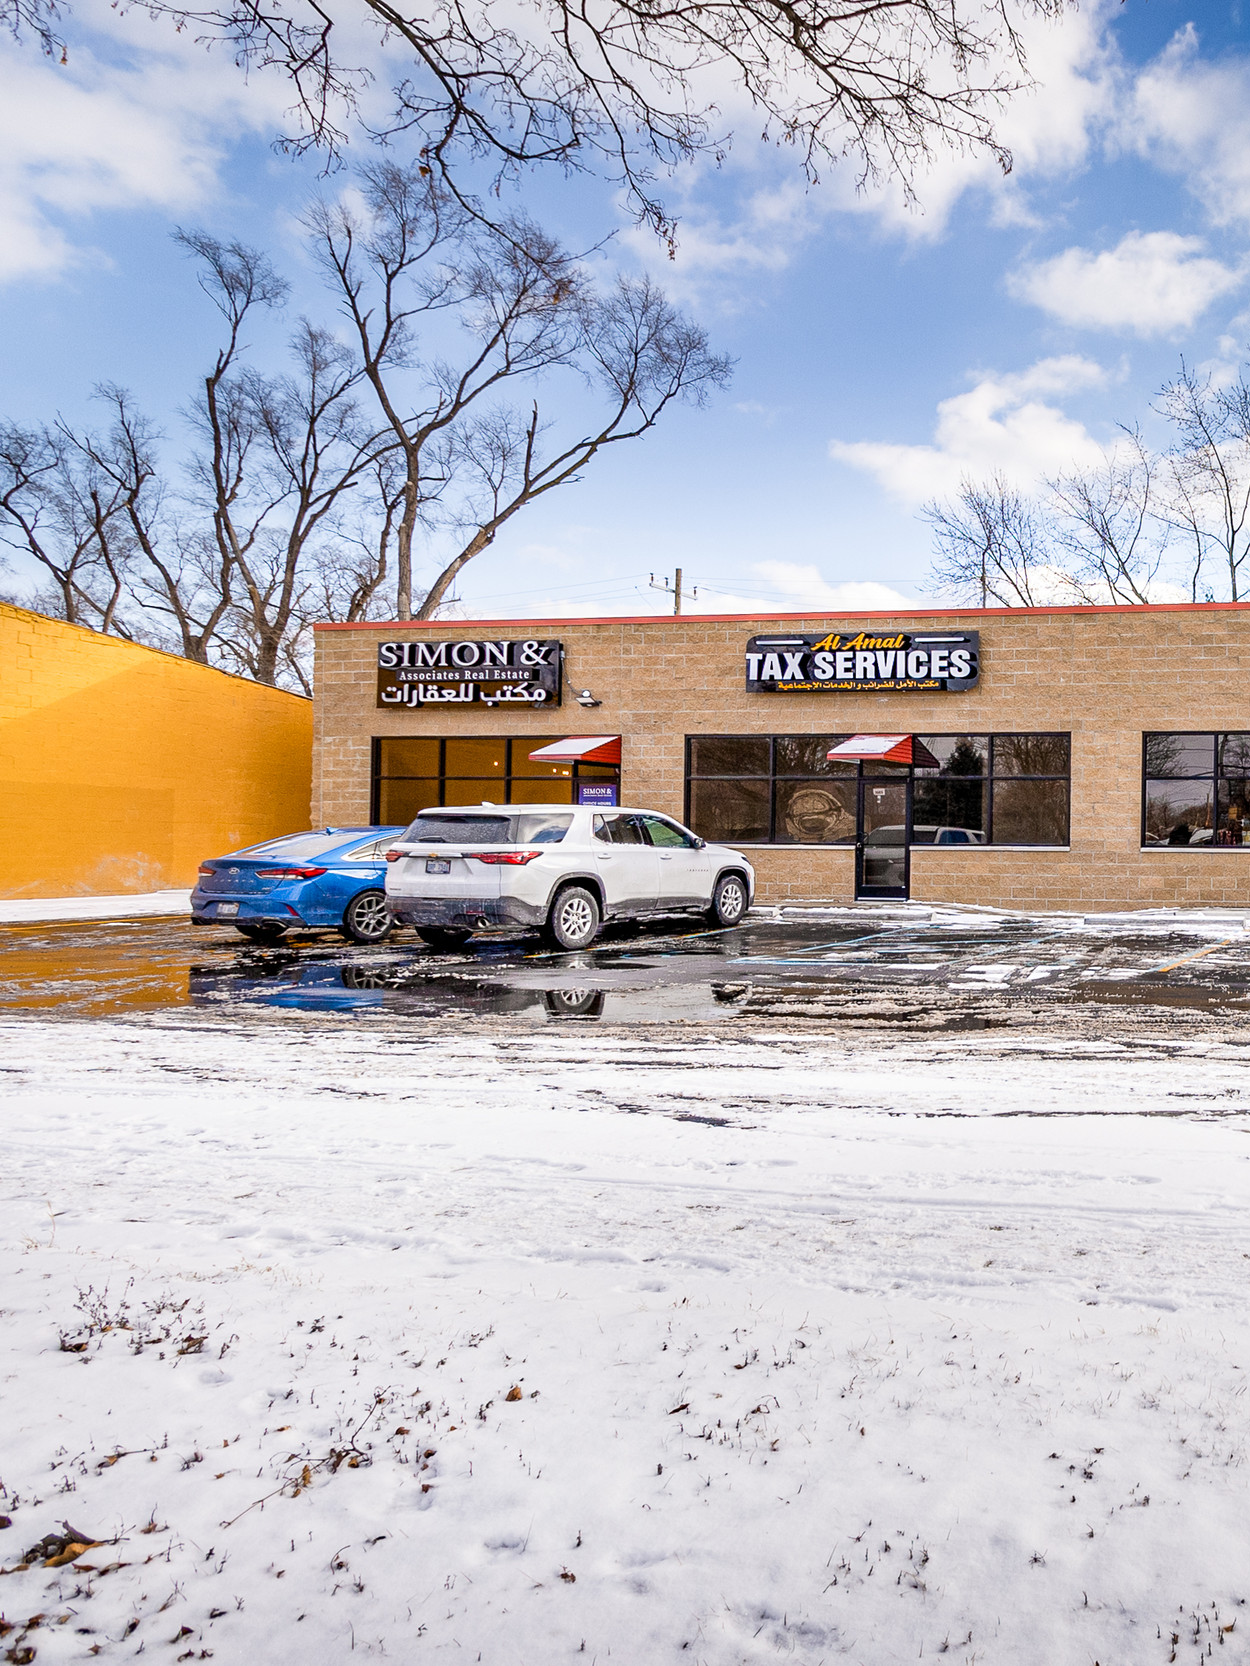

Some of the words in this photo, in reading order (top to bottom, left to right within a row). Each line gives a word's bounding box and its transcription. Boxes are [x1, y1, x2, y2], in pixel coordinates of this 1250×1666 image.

[379, 641, 511, 667] SIMON
[520, 640, 549, 665] &
[811, 633, 841, 651] Al
[842, 633, 905, 651] Amal
[399, 671, 460, 681] Associates
[465, 670, 489, 680] Real
[494, 669, 530, 679] Estate
[745, 653, 804, 680] TAX
[813, 650, 971, 679] SERVICES
[381, 683, 474, 707] للعقارات
[480, 682, 547, 707] مكتب
[917, 680, 940, 690] مكتب
